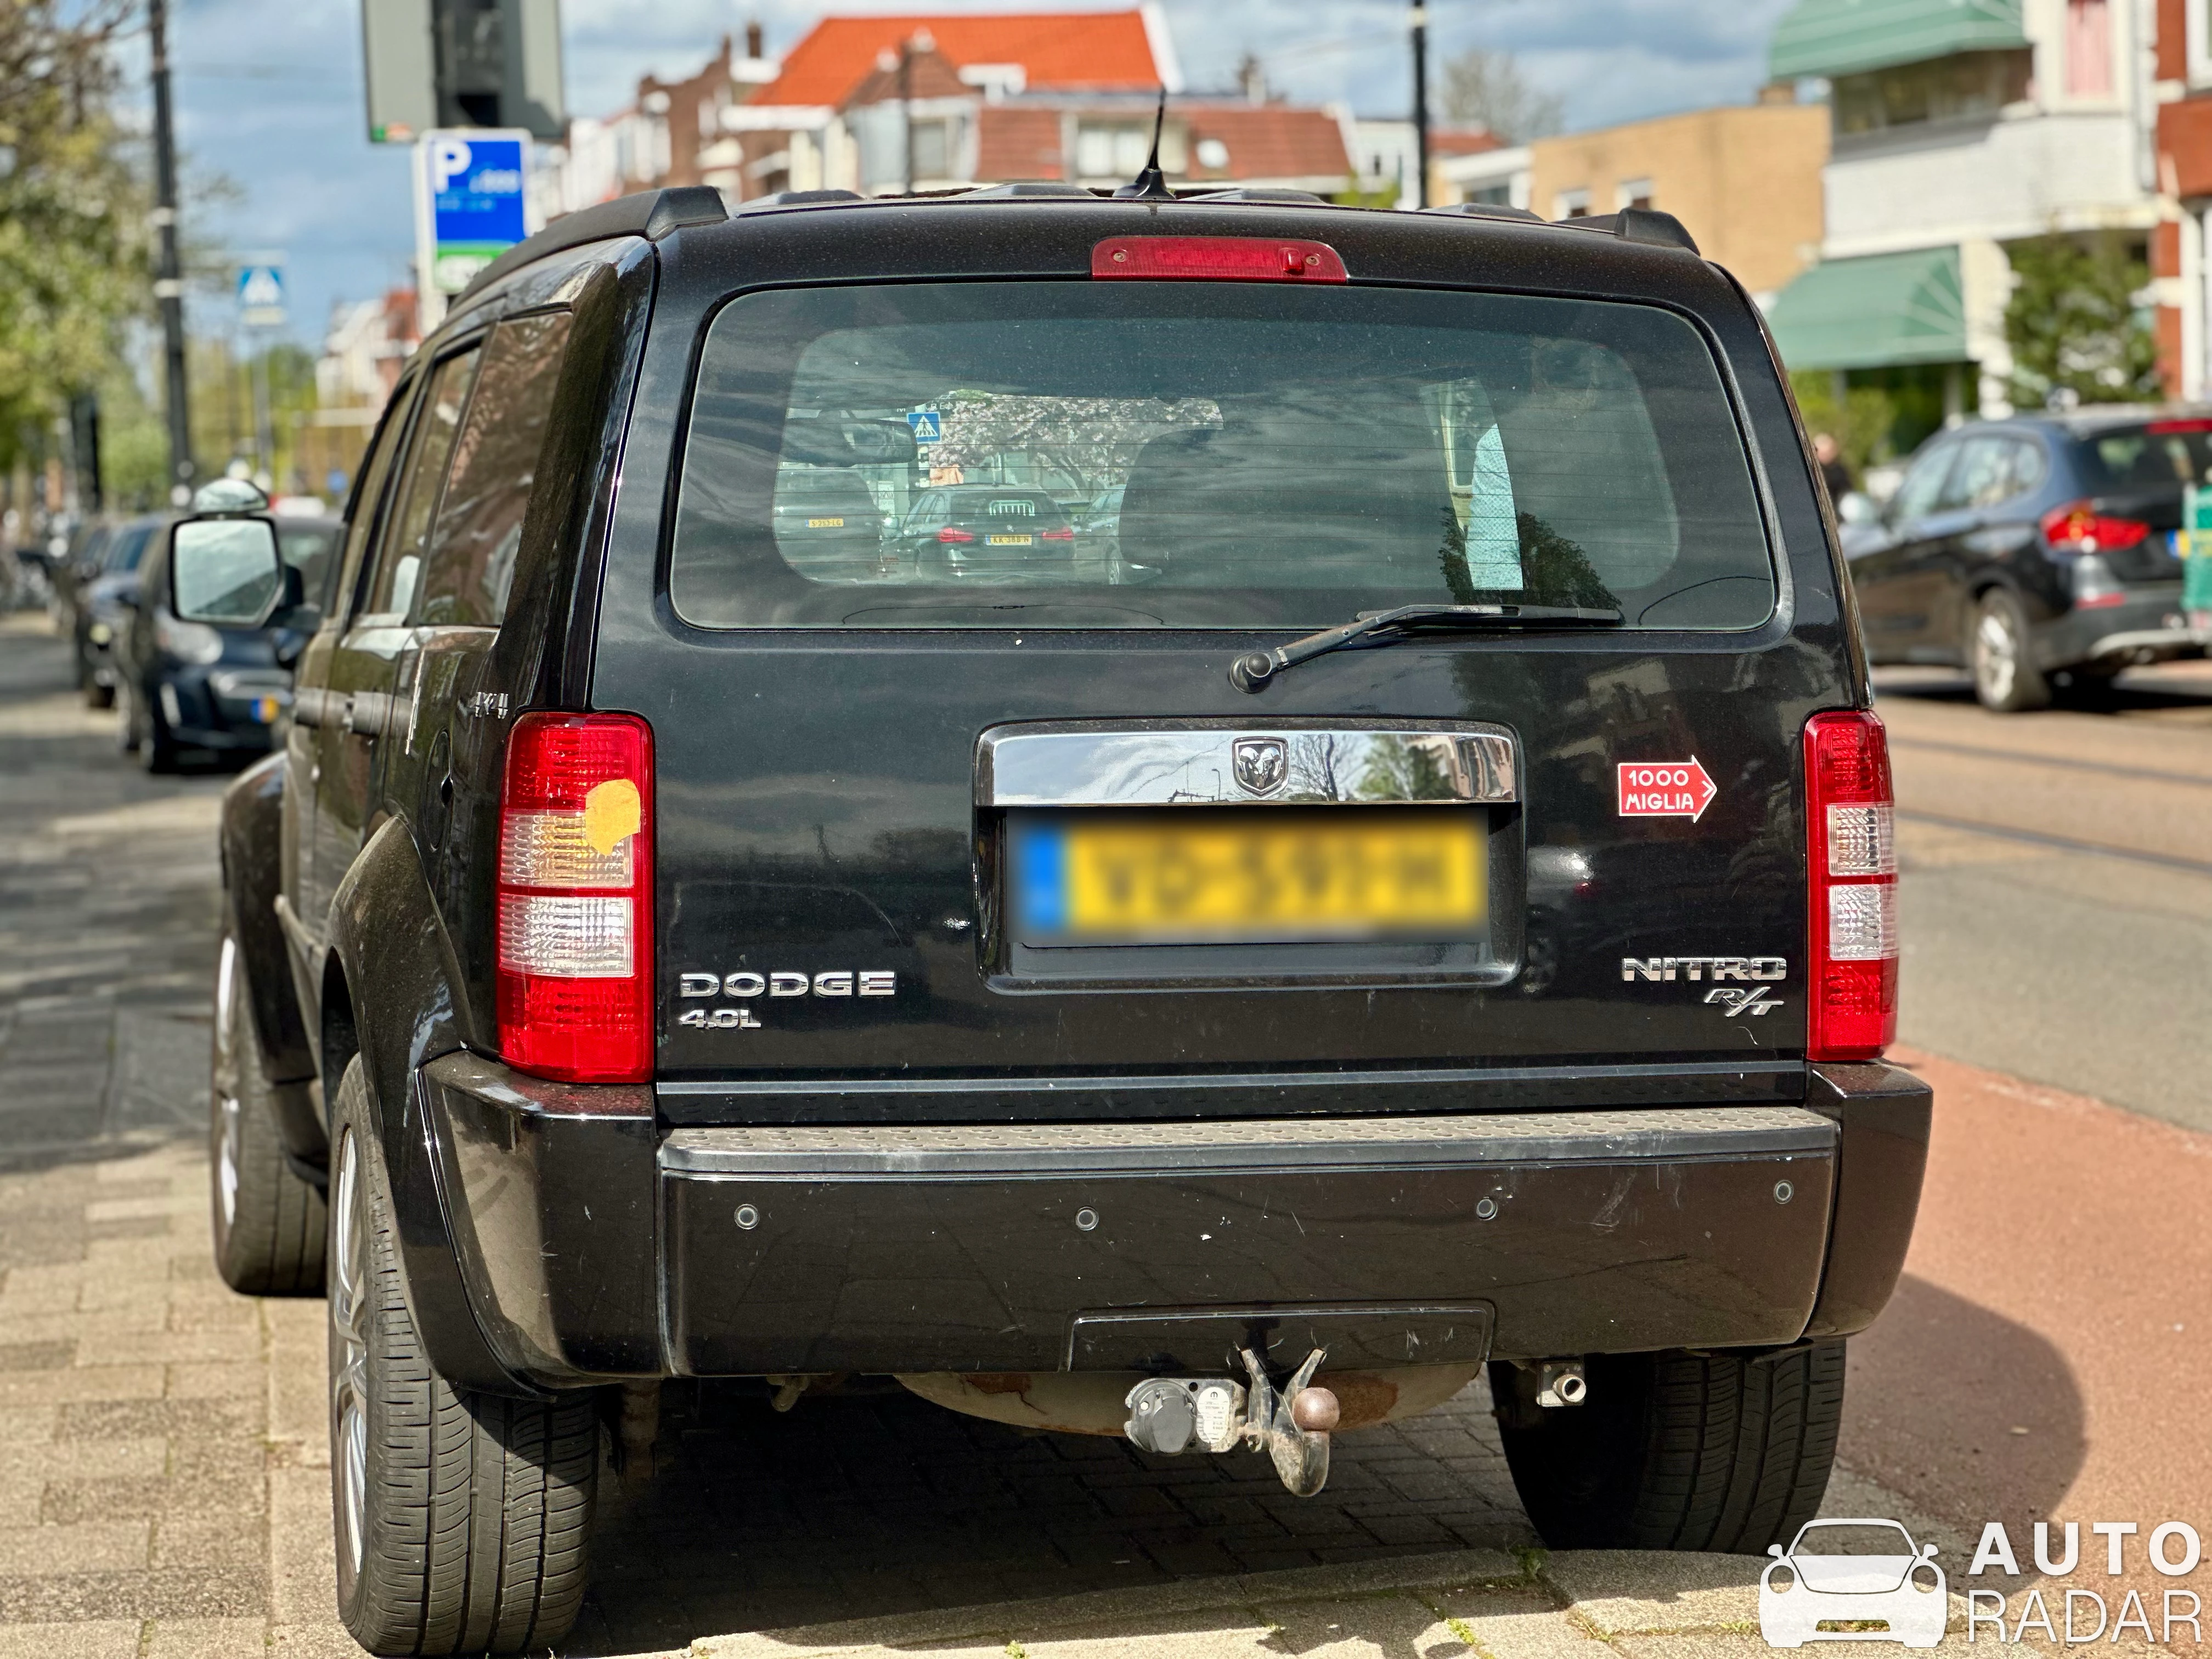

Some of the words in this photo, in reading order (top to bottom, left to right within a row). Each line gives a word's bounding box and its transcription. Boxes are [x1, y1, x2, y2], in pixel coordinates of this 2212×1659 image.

[434, 140, 472, 193] P
[1628, 769, 1689, 787] 1000
[1625, 793, 1694, 811] MIGLIA
[1622, 957, 1787, 981] NITRO
[680, 971, 895, 997] DODGE
[1703, 986, 1784, 1018] R/T
[679, 1008, 762, 1029] 4.0L
